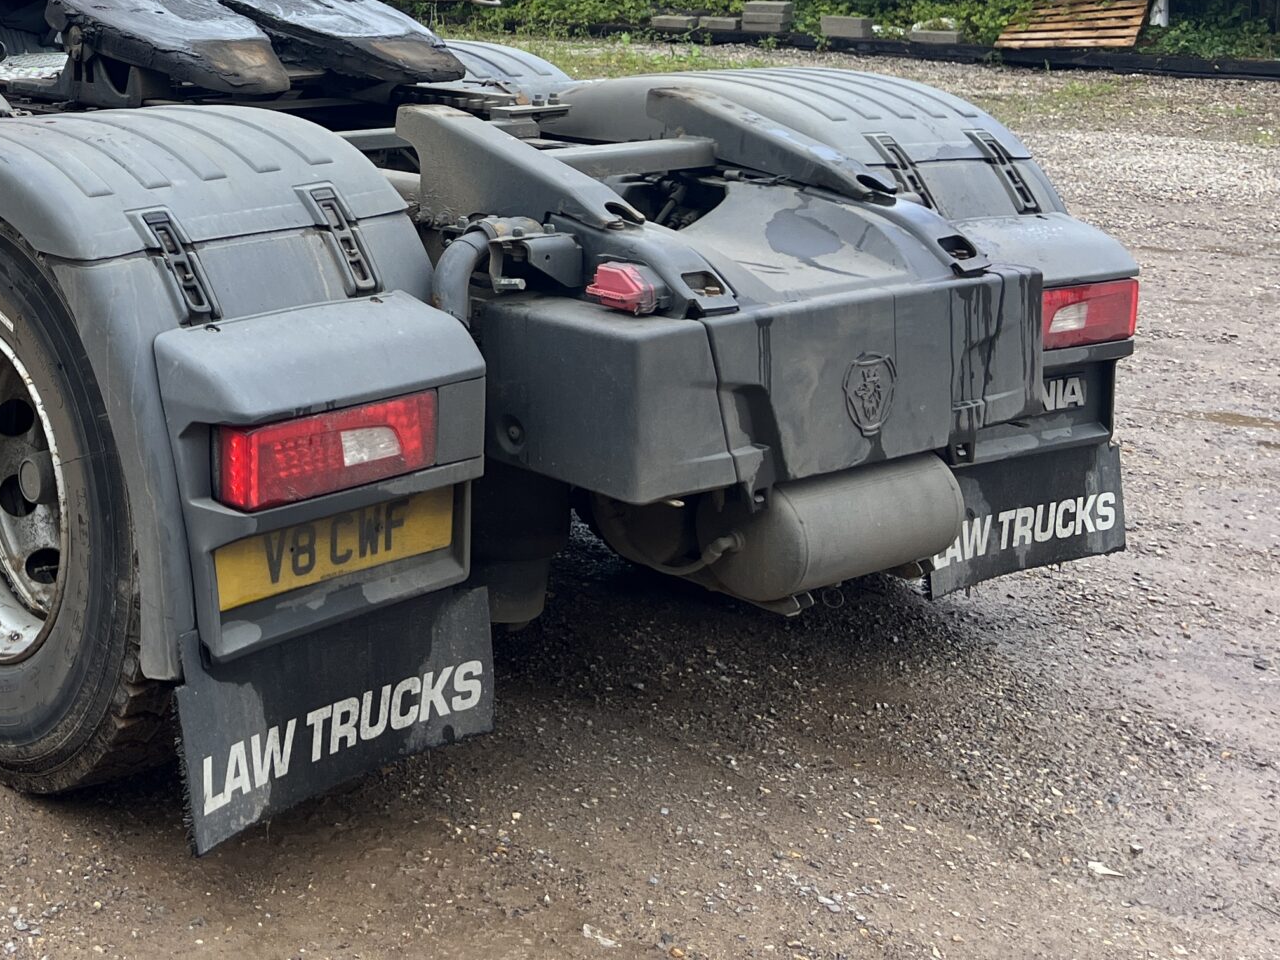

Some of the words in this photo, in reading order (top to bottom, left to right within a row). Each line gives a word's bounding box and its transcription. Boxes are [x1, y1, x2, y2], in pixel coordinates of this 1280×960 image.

[1042, 377, 1085, 411] NIA
[263, 524, 317, 585] V8
[330, 497, 410, 566] CWF
[997, 491, 1116, 551] TRUCKS
[203, 718, 297, 815] LAW
[306, 660, 483, 764] TRUCKS
